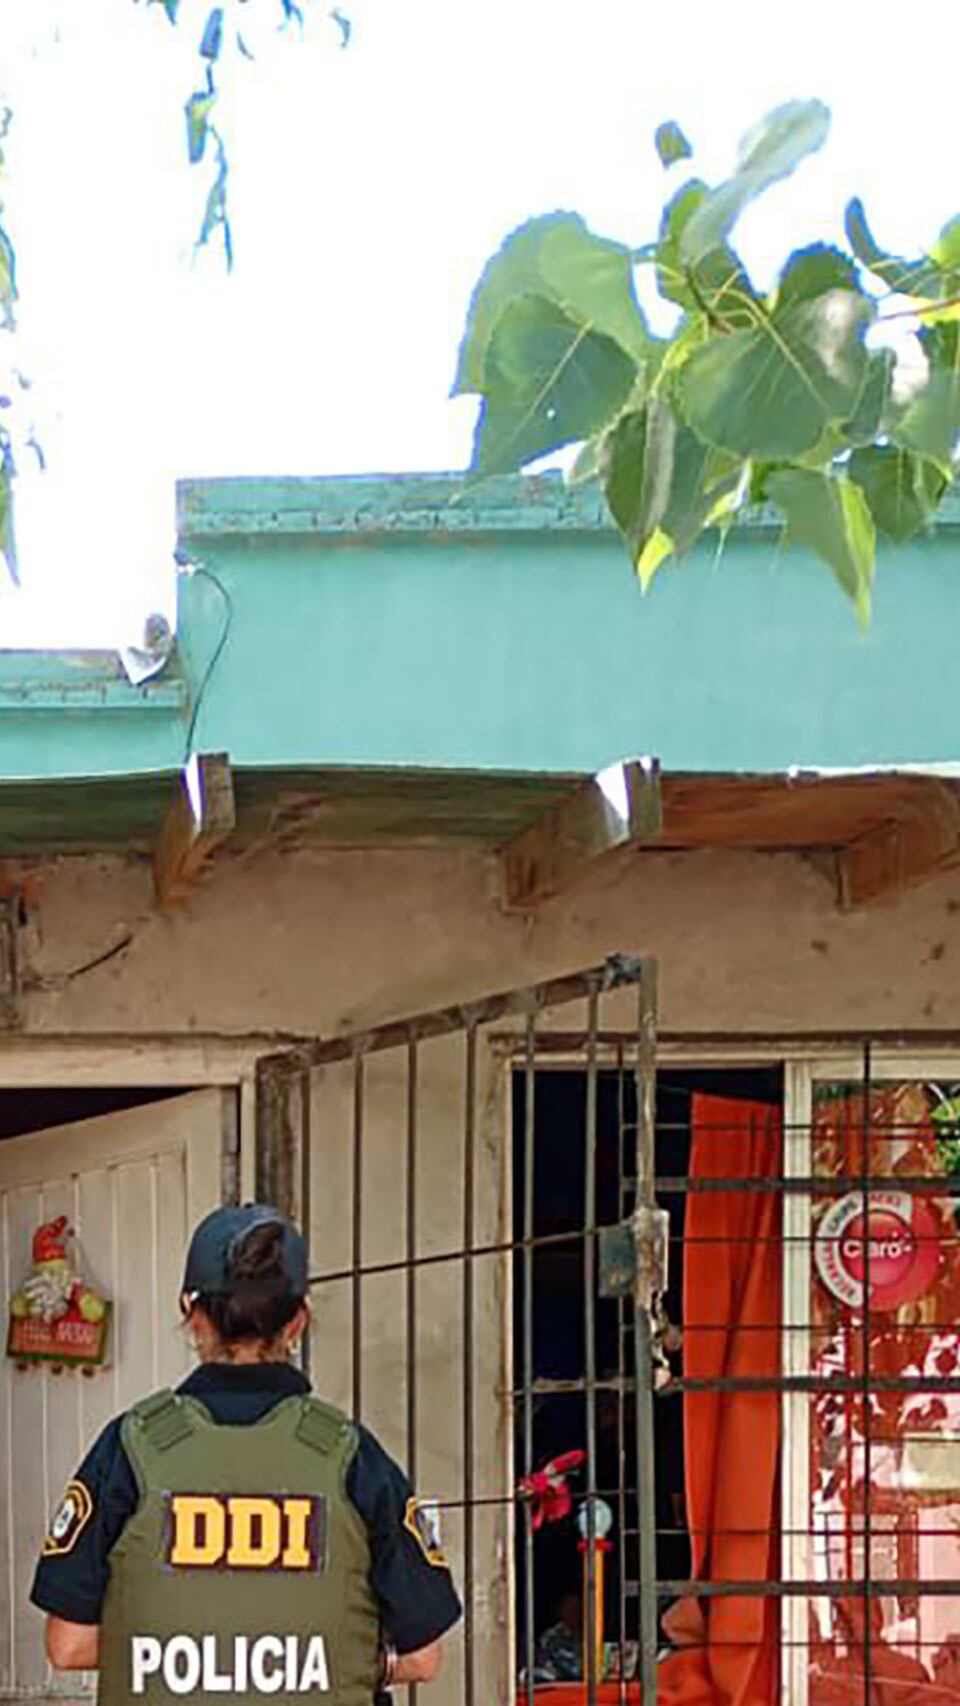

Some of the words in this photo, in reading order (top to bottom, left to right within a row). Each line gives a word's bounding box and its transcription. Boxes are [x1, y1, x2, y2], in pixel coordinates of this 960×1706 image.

[842, 1238, 902, 1259] Caro
[171, 1496, 312, 1568] DDI
[131, 1634, 330, 1694] POLICIA
